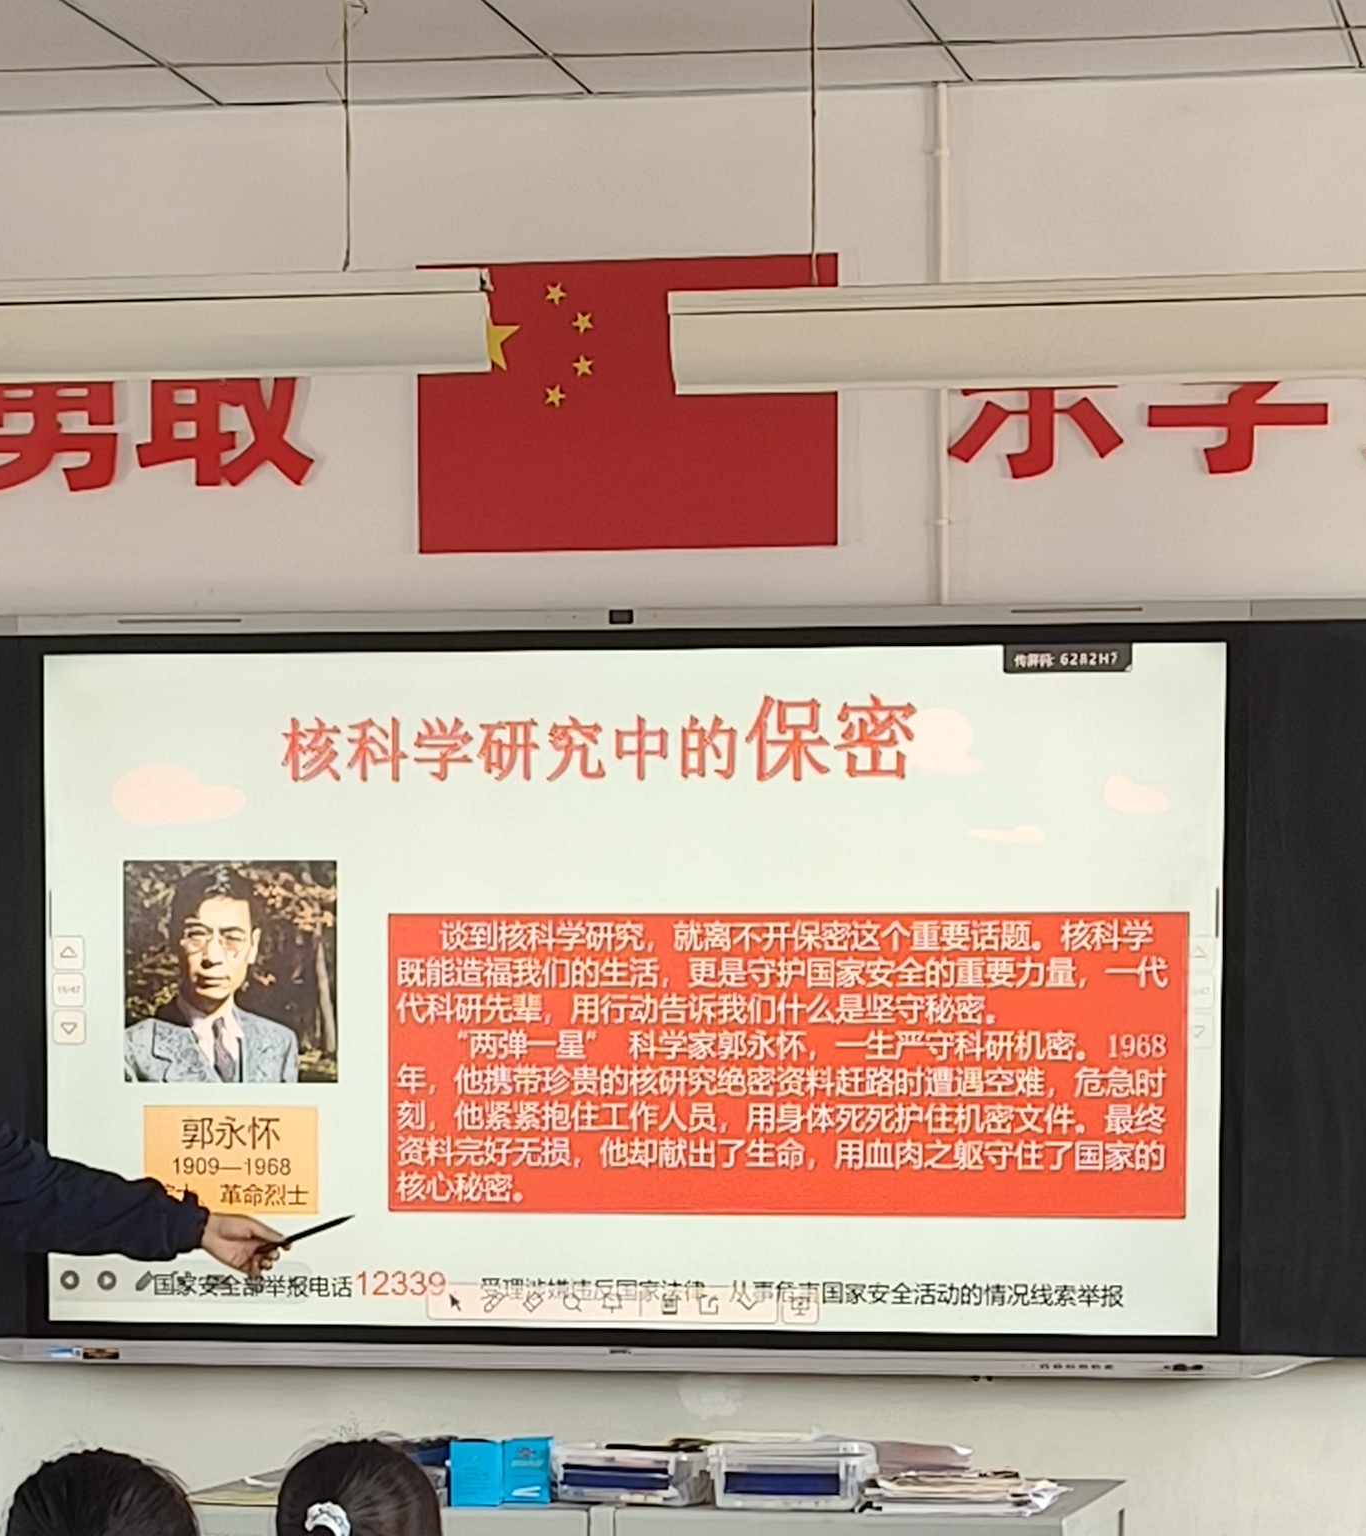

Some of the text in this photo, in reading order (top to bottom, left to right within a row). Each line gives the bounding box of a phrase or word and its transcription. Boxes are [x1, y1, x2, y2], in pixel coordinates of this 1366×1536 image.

[281, 693, 917, 784] 核科学研究中的保密
[181, 1116, 281, 1150] 郭永怀
